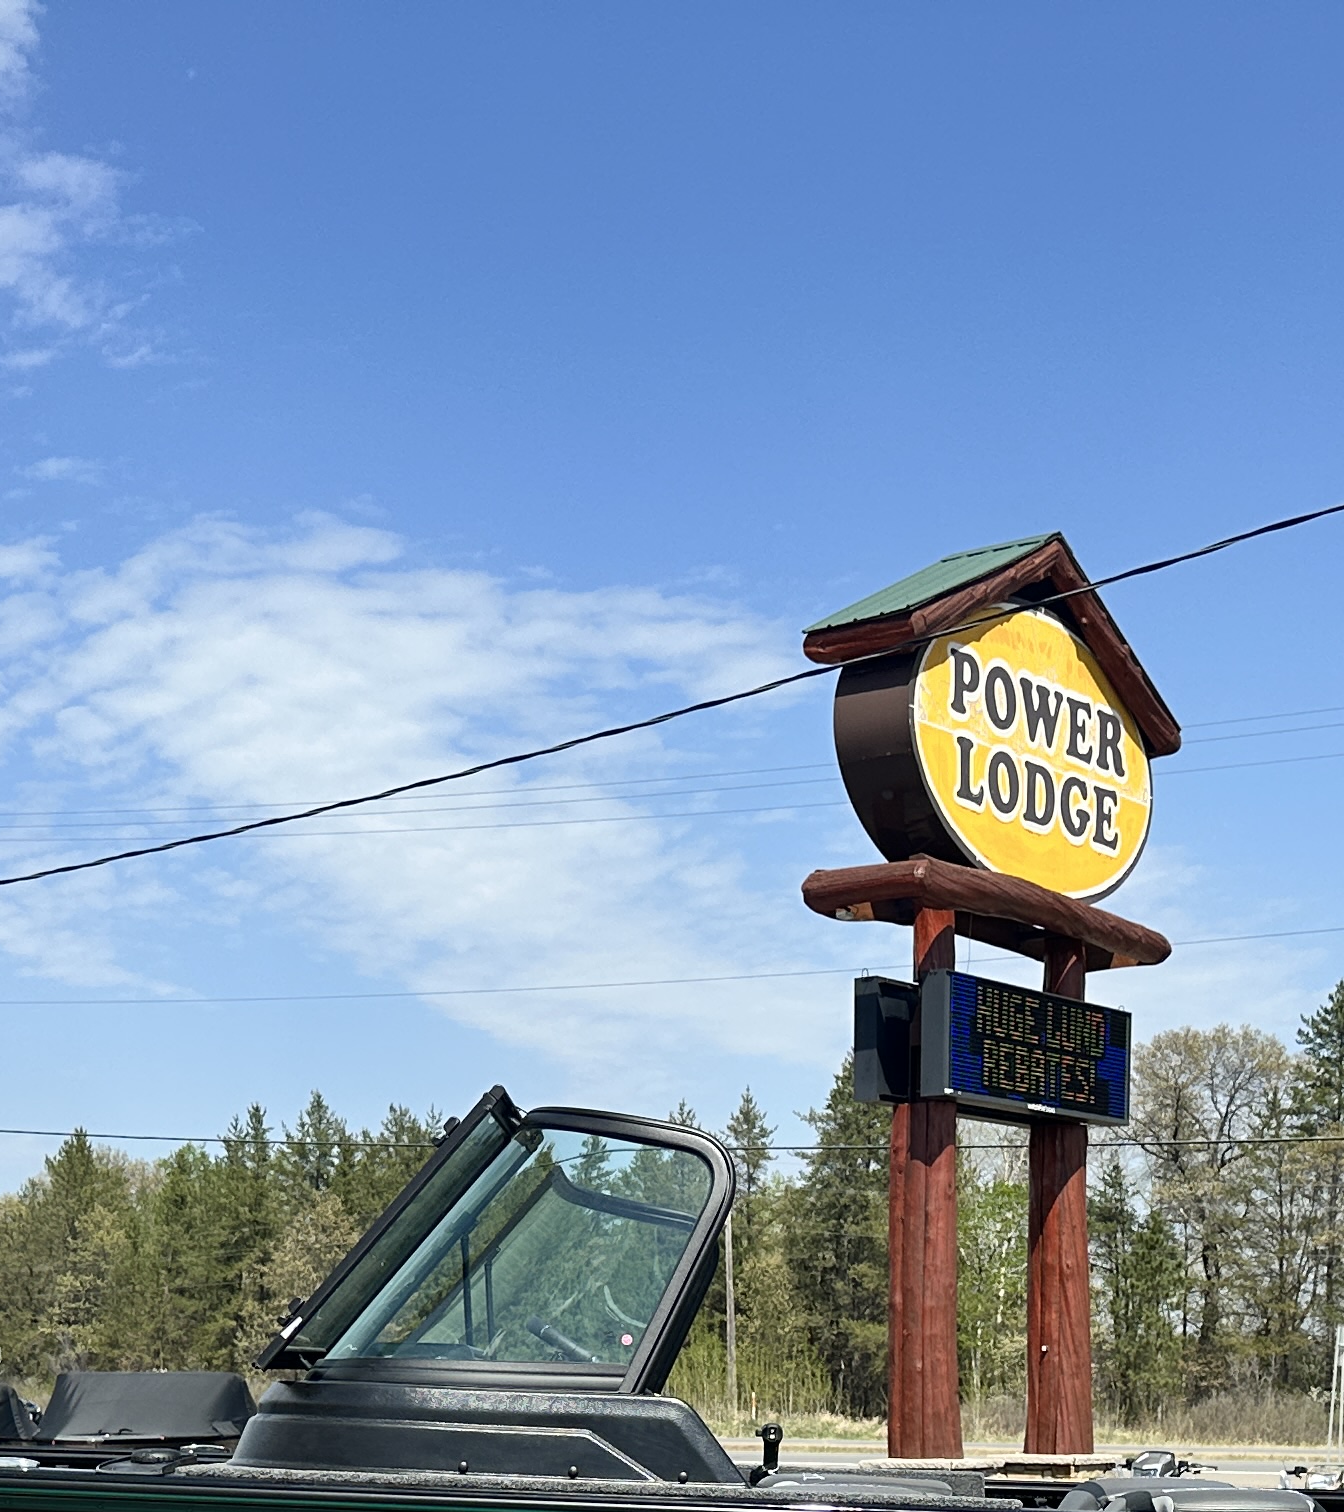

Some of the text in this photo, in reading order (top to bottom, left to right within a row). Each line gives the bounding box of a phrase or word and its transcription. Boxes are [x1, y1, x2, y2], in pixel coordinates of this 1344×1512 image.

[951, 648, 1125, 777] POWER
[956, 736, 1119, 850] LODGE
[976, 985, 1105, 1057] HUGE LUND
